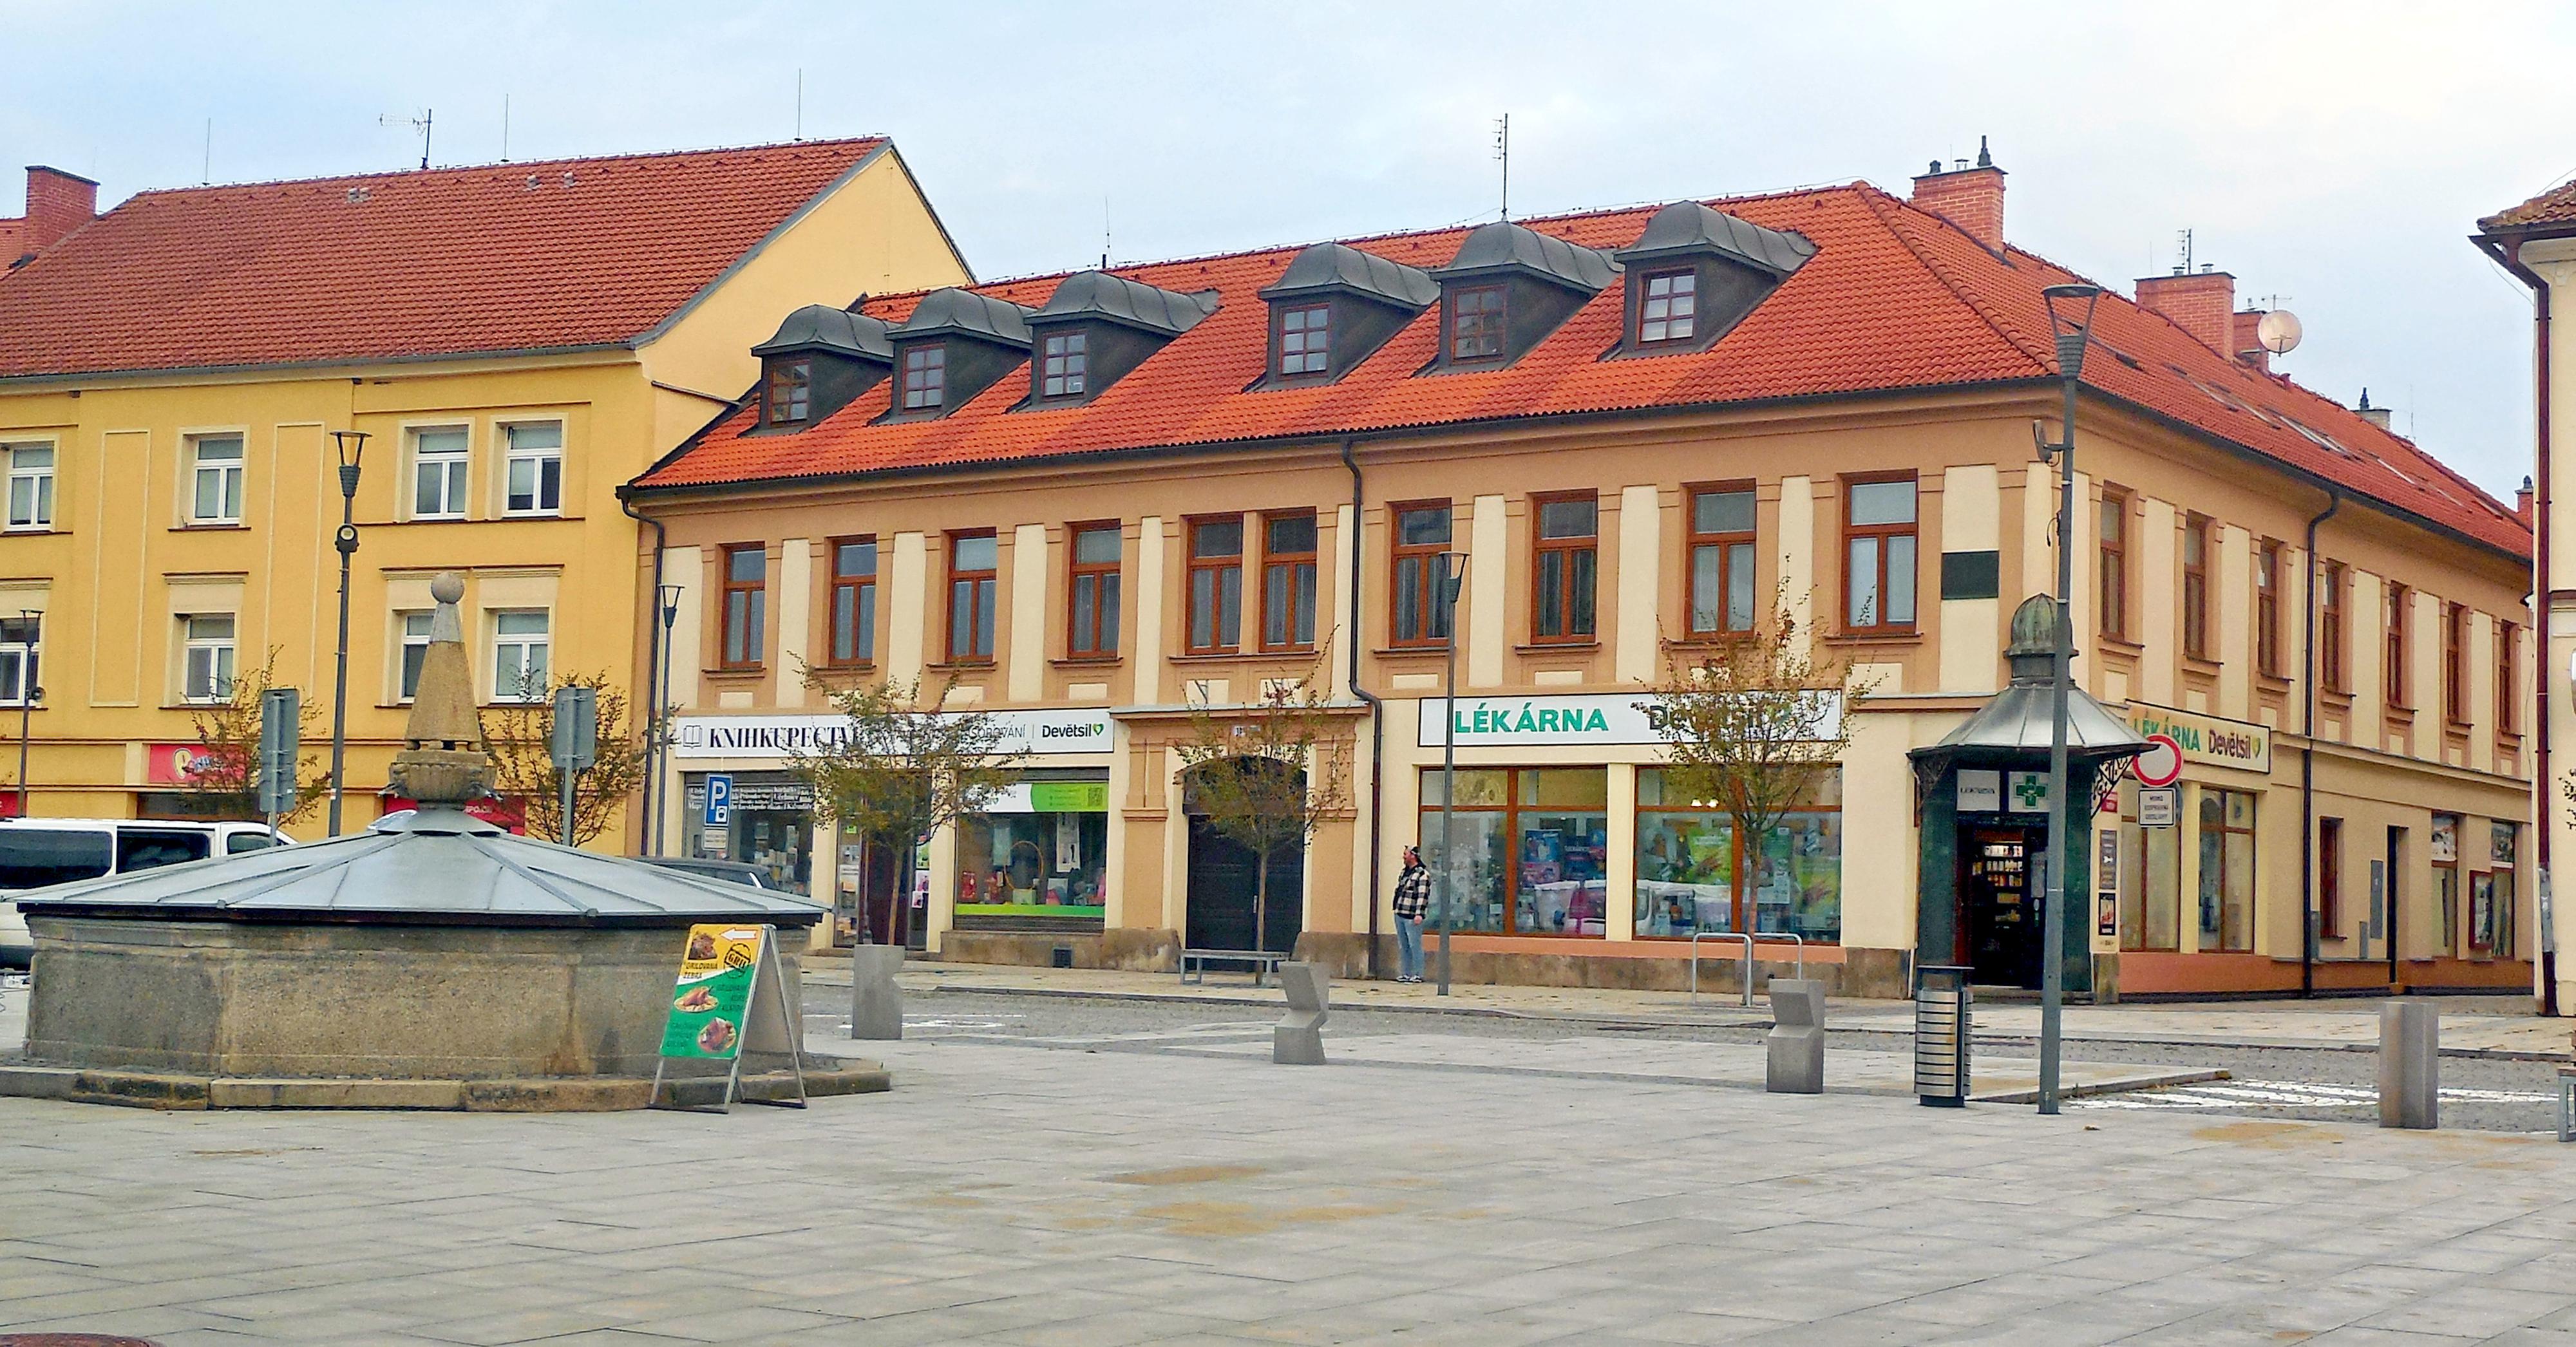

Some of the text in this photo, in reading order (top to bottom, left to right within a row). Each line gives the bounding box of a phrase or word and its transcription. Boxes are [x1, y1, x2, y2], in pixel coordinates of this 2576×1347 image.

[1041, 722, 1092, 739] Devětsil
[1454, 702, 1609, 733] LÉKÁRNA
[2208, 728, 2251, 760] Devětsil
[710, 780, 728, 810] P
